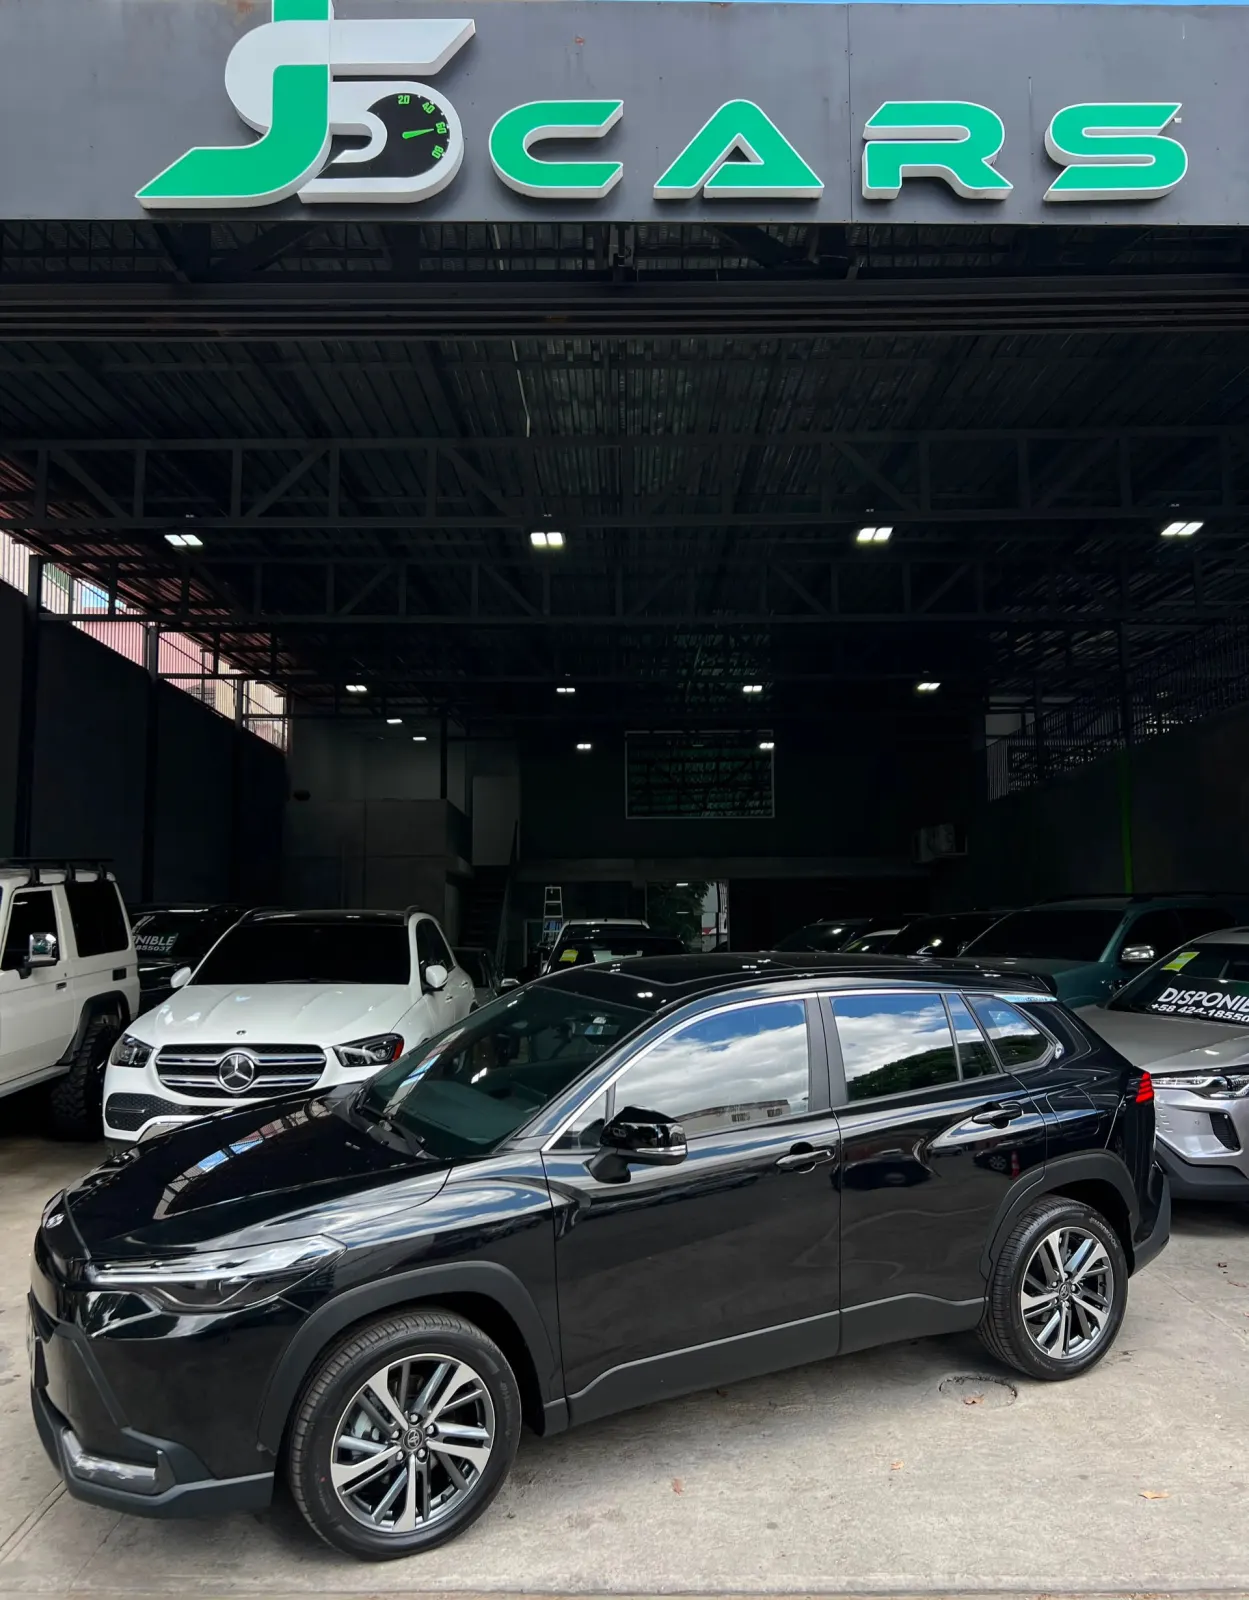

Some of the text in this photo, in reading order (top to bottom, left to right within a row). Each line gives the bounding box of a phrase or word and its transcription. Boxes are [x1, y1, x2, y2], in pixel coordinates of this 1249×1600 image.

[397, 94, 411, 105] 20
[421, 101, 436, 114] 40
[435, 121, 447, 135] 60
[431, 144, 444, 160] 80
[489, 98, 1188, 202] CARS
[134, 934, 176, 946] NIBLE
[1151, 1003, 1177, 1013] +58
